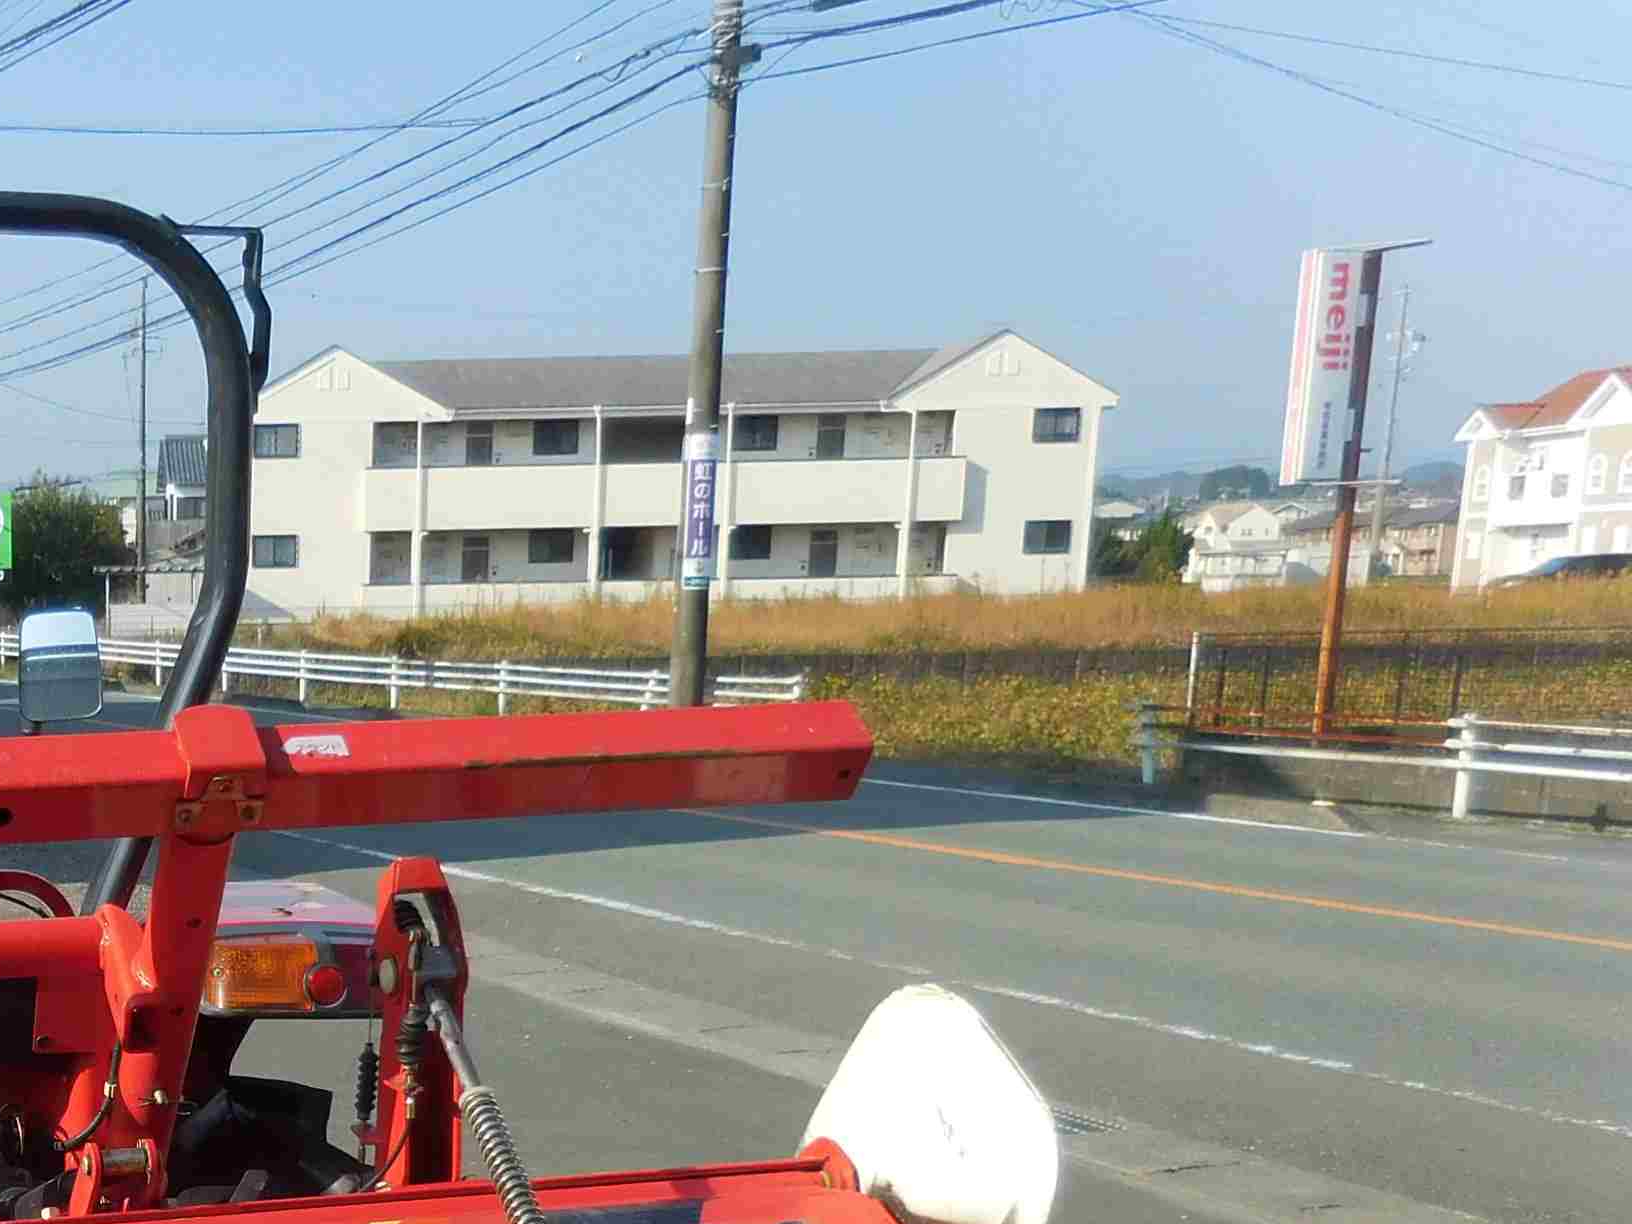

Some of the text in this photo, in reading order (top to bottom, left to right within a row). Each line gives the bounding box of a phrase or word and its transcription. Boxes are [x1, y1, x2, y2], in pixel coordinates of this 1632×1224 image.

[1317, 262, 1350, 371] meiji
[690, 463, 713, 556] 虹のホール
